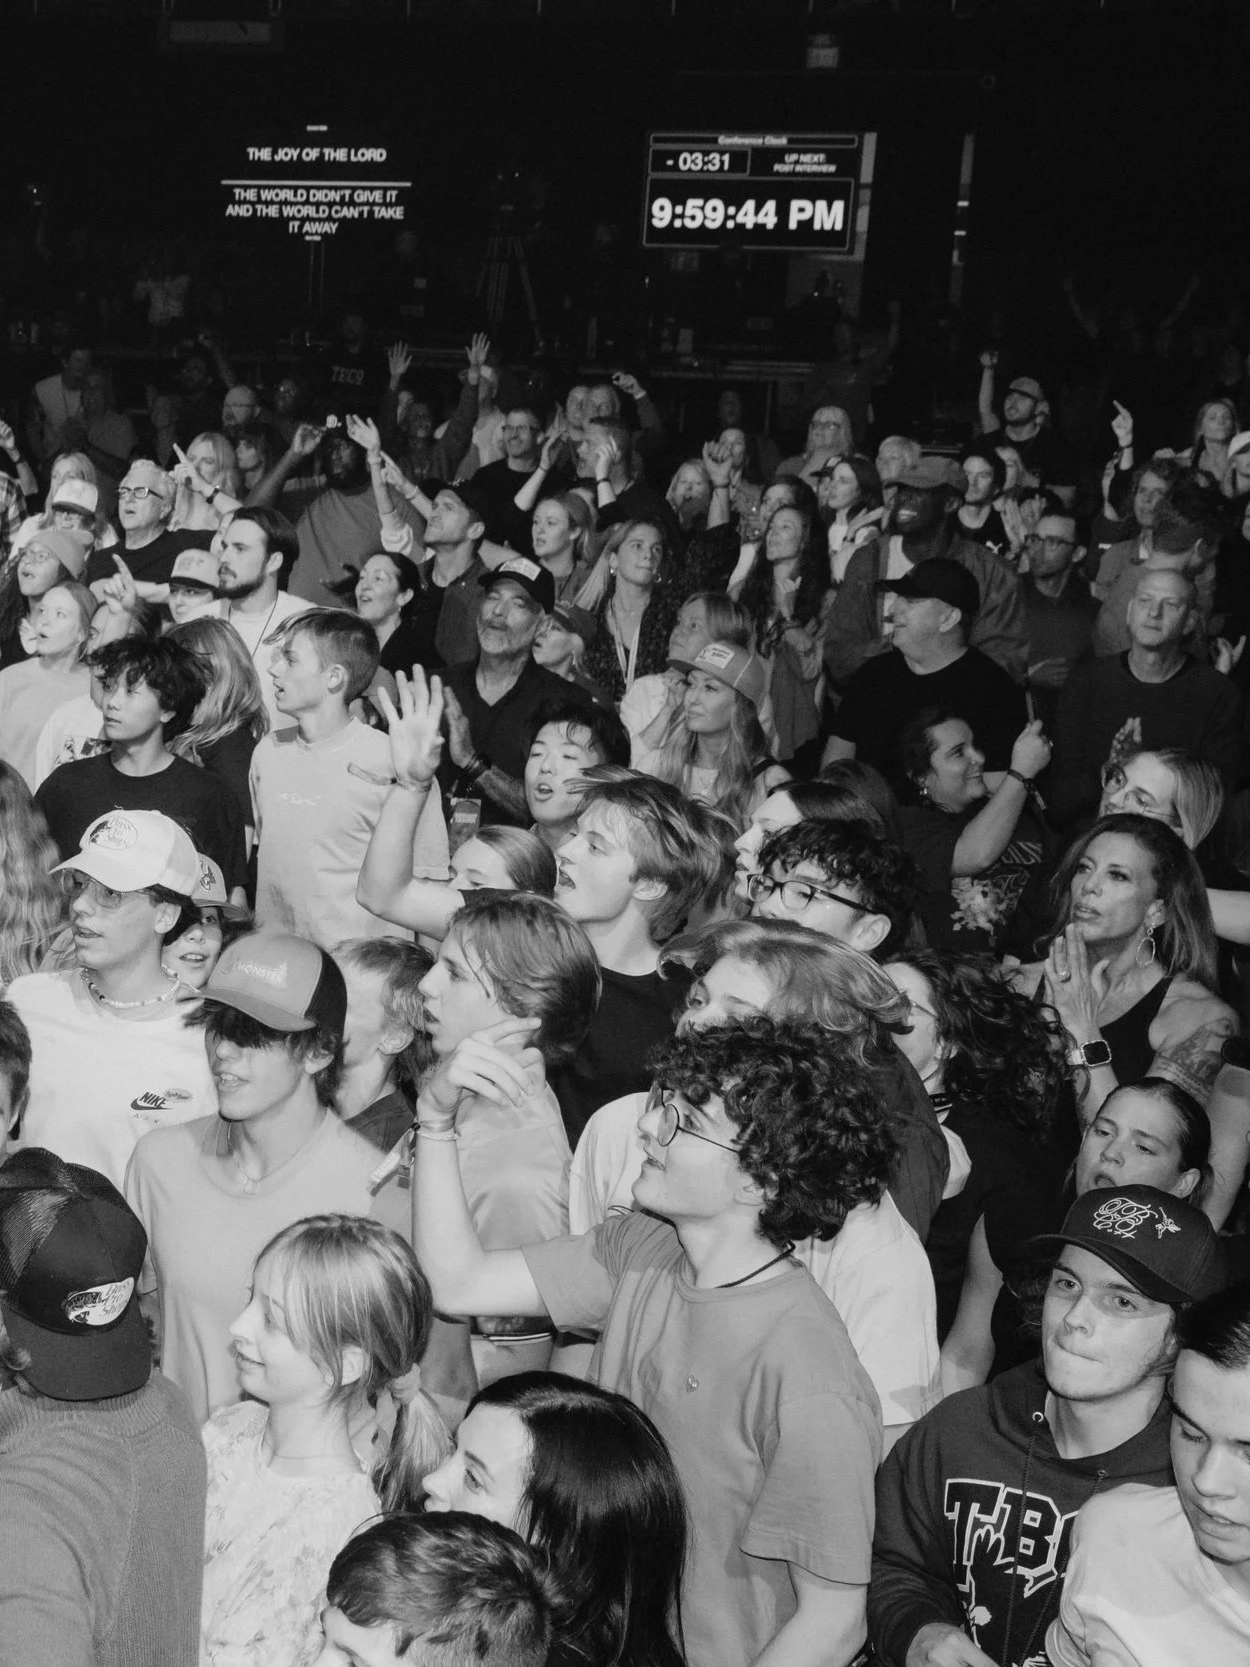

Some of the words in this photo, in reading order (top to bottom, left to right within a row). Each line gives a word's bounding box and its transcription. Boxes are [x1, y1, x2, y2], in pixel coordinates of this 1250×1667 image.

[247, 148, 272, 161] THE
[274, 148, 301, 161] JOY
[302, 148, 320, 161] OF
[323, 148, 347, 161] THE
[350, 148, 387, 162] LORD
[678, 152, 730, 171] 03:31
[233, 188, 257, 201] THE
[259, 188, 307, 202] WORLD
[309, 189, 352, 202] DIDN'T
[353, 190, 384, 203] GIVE
[386, 190, 398, 203] IT
[225, 204, 253, 217] AND
[255, 205, 280, 217] THE
[282, 205, 329, 218] WORLD
[331, 206, 370, 218] CAN'T
[372, 206, 405, 219] TAKE
[651, 197, 778, 230] 9:59:44
[787, 199, 846, 231] PM
[288, 220, 301, 234] IT
[302, 221, 339, 234] AWAY
[139, 1091, 167, 1108] NIKE
[944, 1478, 1079, 1598] TB
